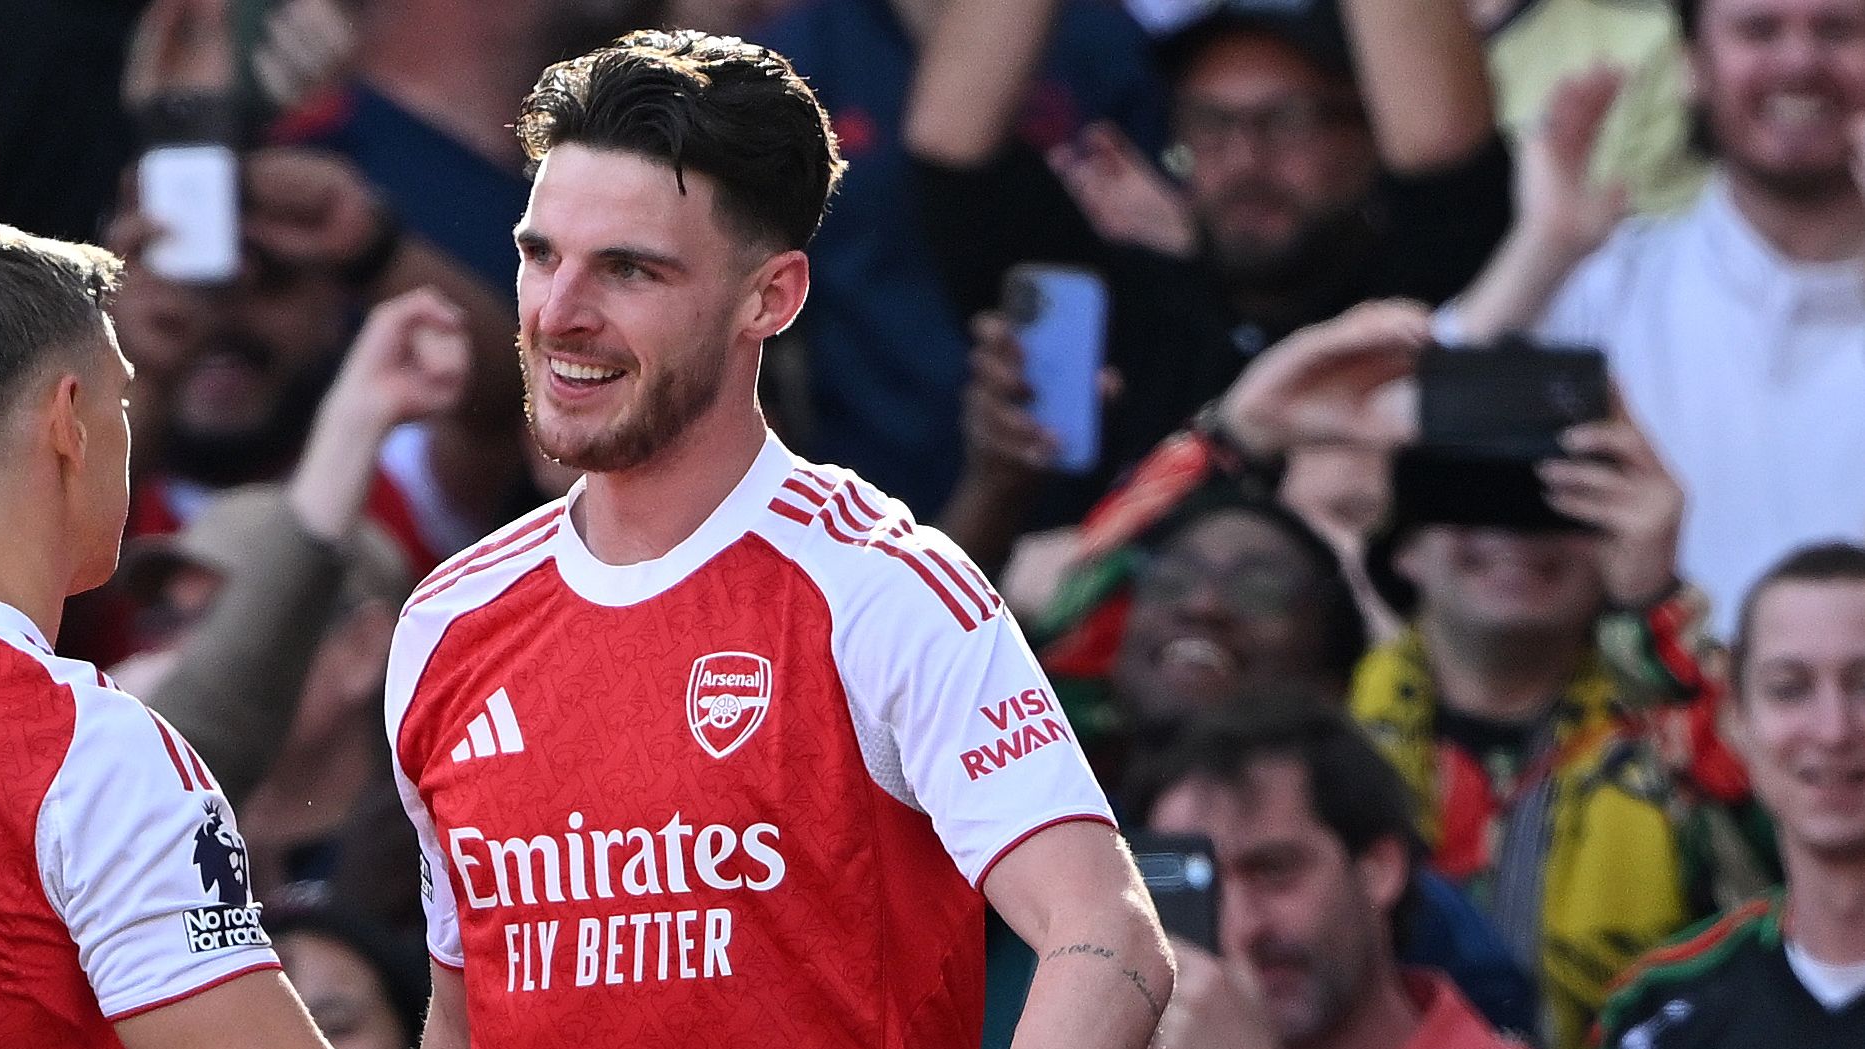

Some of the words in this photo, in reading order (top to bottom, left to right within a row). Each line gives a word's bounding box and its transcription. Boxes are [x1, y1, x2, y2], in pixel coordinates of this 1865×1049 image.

[700, 670, 760, 688] Arsenal
[979, 687, 1054, 732] VISI
[960, 717, 1072, 782] RWAN
[448, 810, 786, 909] Emirates
[183, 908, 221, 932] No
[189, 930, 222, 953] for
[504, 919, 559, 993] FLY
[574, 907, 733, 988] BETTER
